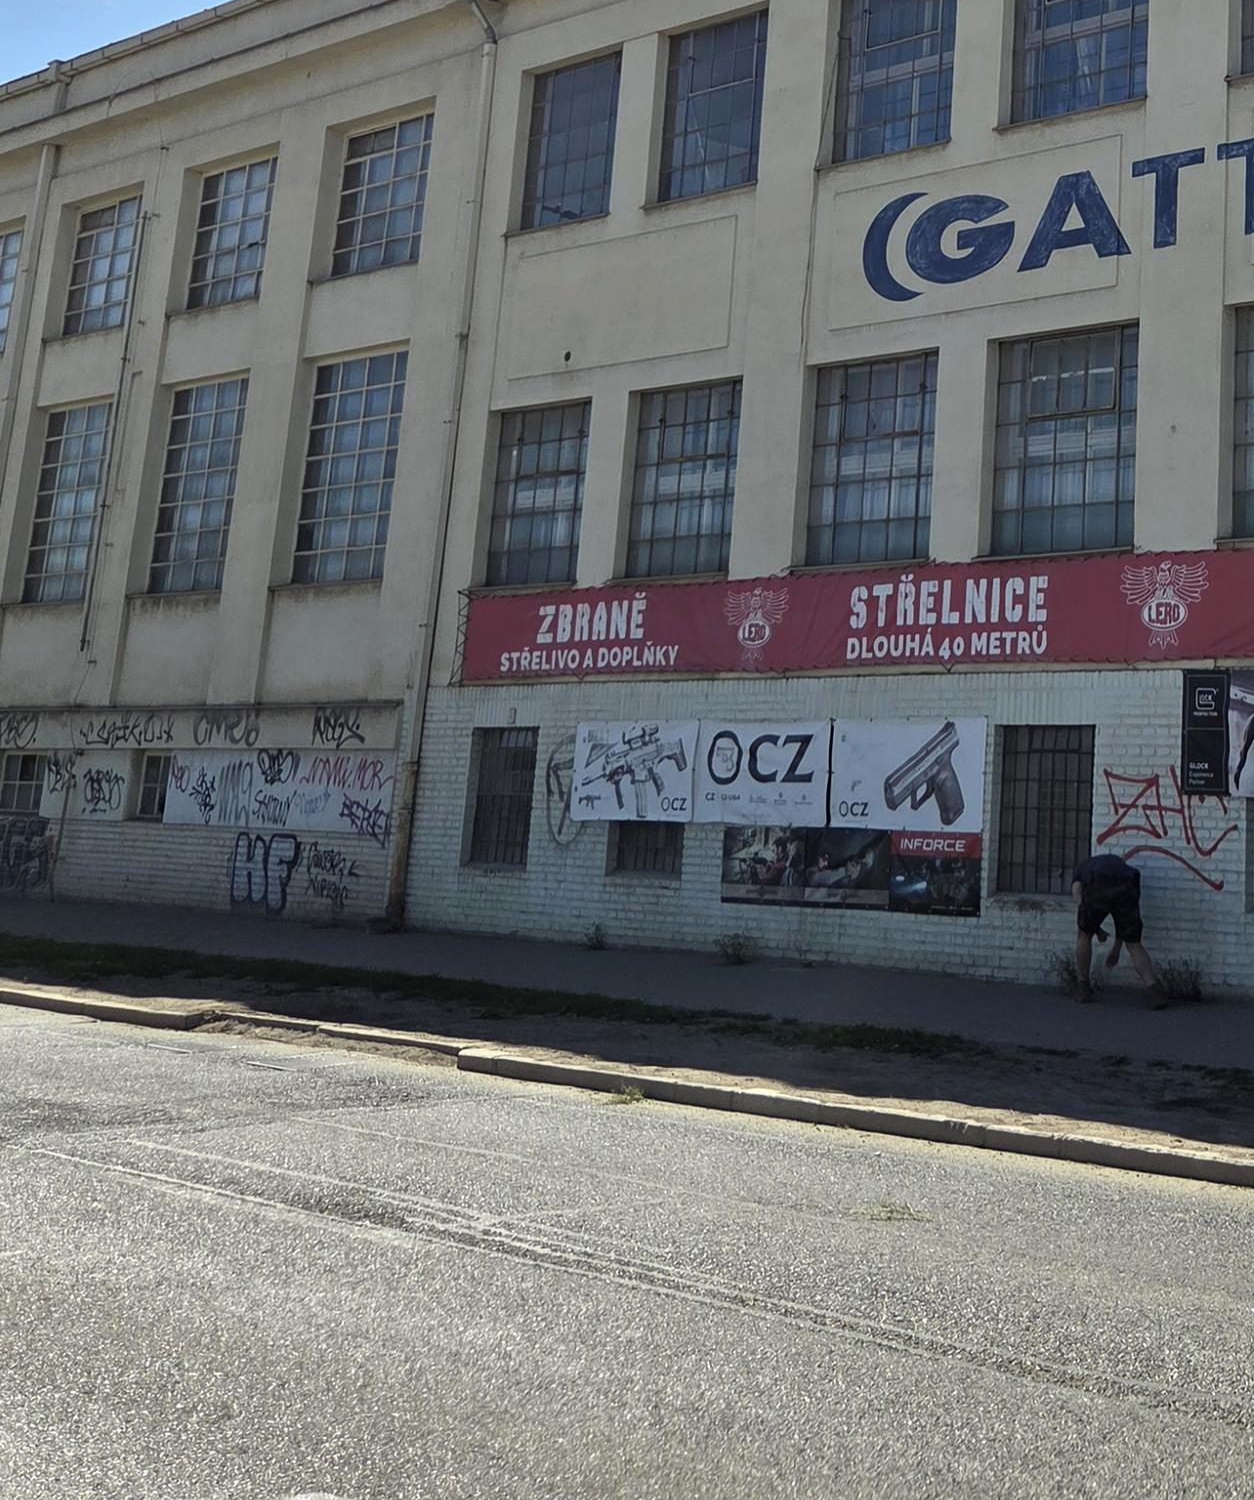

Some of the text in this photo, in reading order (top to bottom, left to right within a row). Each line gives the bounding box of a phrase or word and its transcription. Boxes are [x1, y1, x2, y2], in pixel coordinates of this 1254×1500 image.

[536, 591, 648, 644] ZBRANĚ
[848, 573, 1048, 630] STŘELNICE
[500, 640, 679, 673] STŘELIVO A DOPLŇKY
[845, 623, 1048, 662] DLOUHÁ 40 METRŮ
[899, 837, 967, 853] INFORCE
